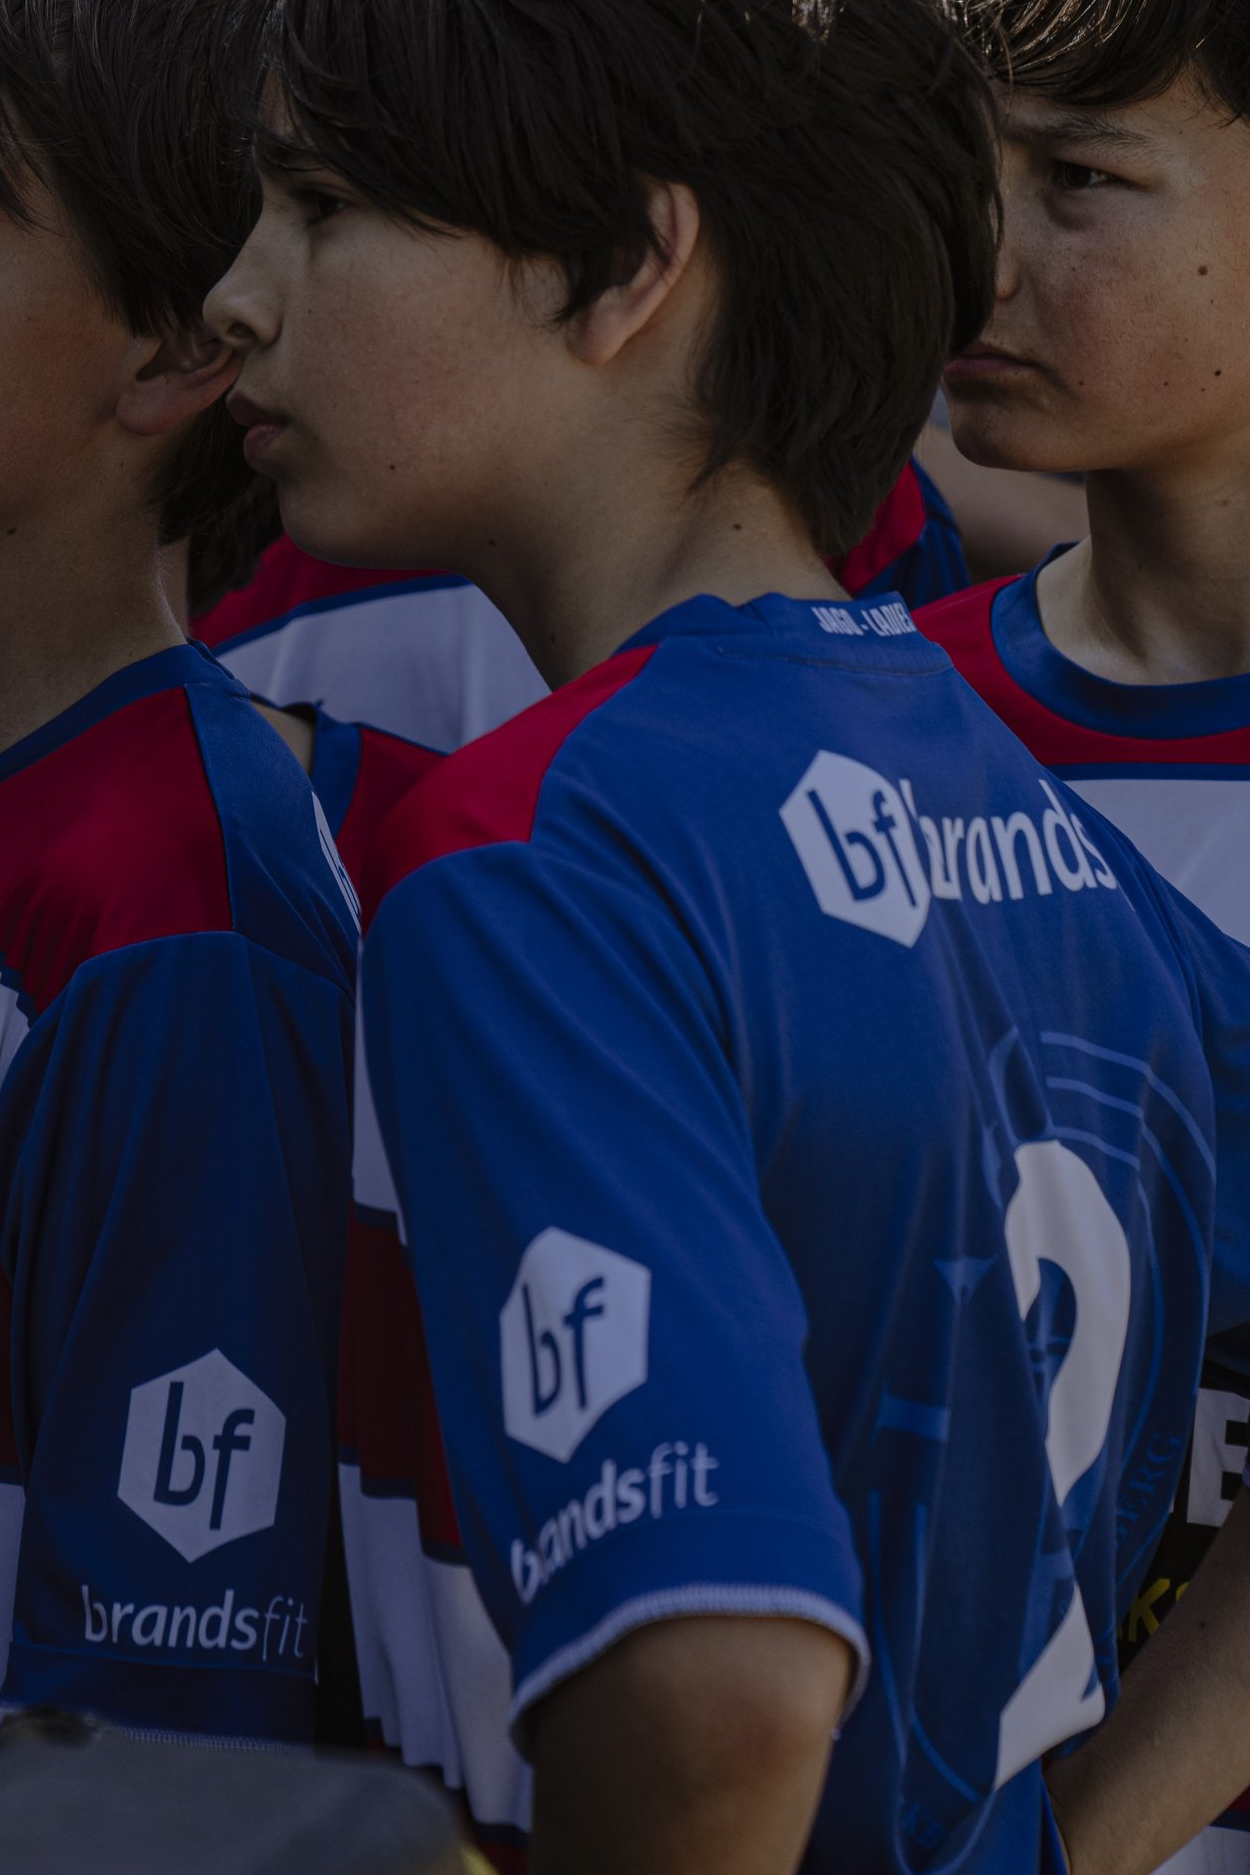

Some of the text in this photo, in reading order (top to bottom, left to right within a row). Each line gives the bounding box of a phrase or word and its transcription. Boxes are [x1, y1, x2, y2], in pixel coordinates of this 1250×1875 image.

[807, 778, 1119, 909] bf brands
[522, 1276, 605, 1415] bf
[153, 1381, 256, 1531] bf
[81, 1584, 309, 1662] brandsfit
